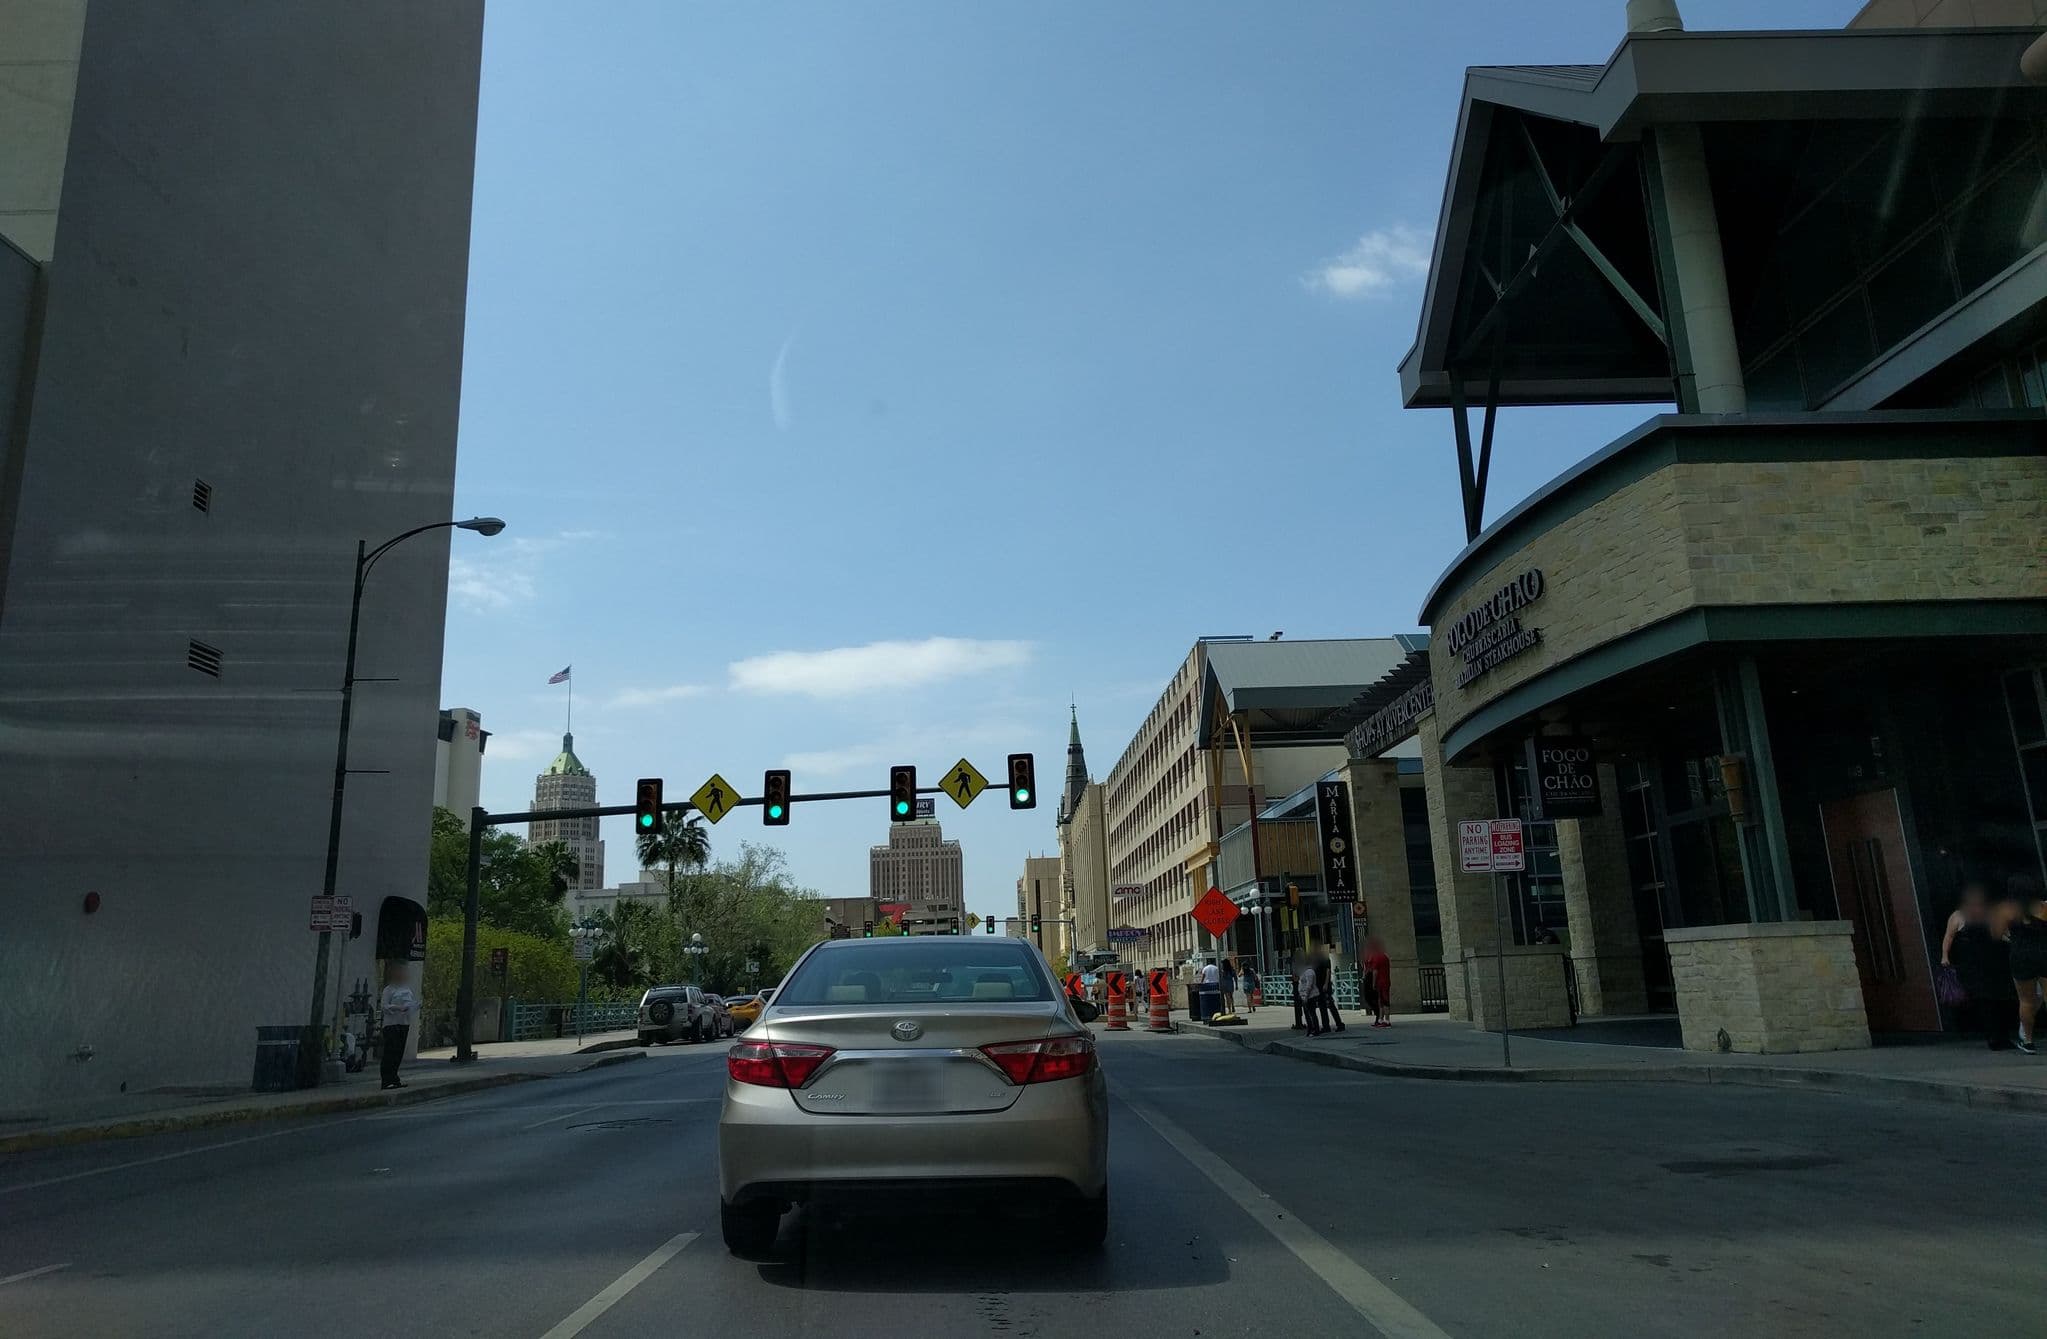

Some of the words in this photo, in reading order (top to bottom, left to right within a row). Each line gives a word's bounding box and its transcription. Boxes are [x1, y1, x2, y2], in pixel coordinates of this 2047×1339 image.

[1475, 601, 1492, 633] DE
[1483, 630, 1539, 672] STEAKHOUSE
[1542, 749, 1589, 763] FOGO
[1558, 763, 1576, 774] DE
[1326, 785, 1341, 834] MARIA
[1467, 825, 1482, 834] NO
[1463, 836, 1488, 846] PARKING
[1465, 847, 1488, 855] ANYTIME
[1332, 857, 1346, 888] MIA
[337, 897, 349, 905] NO
